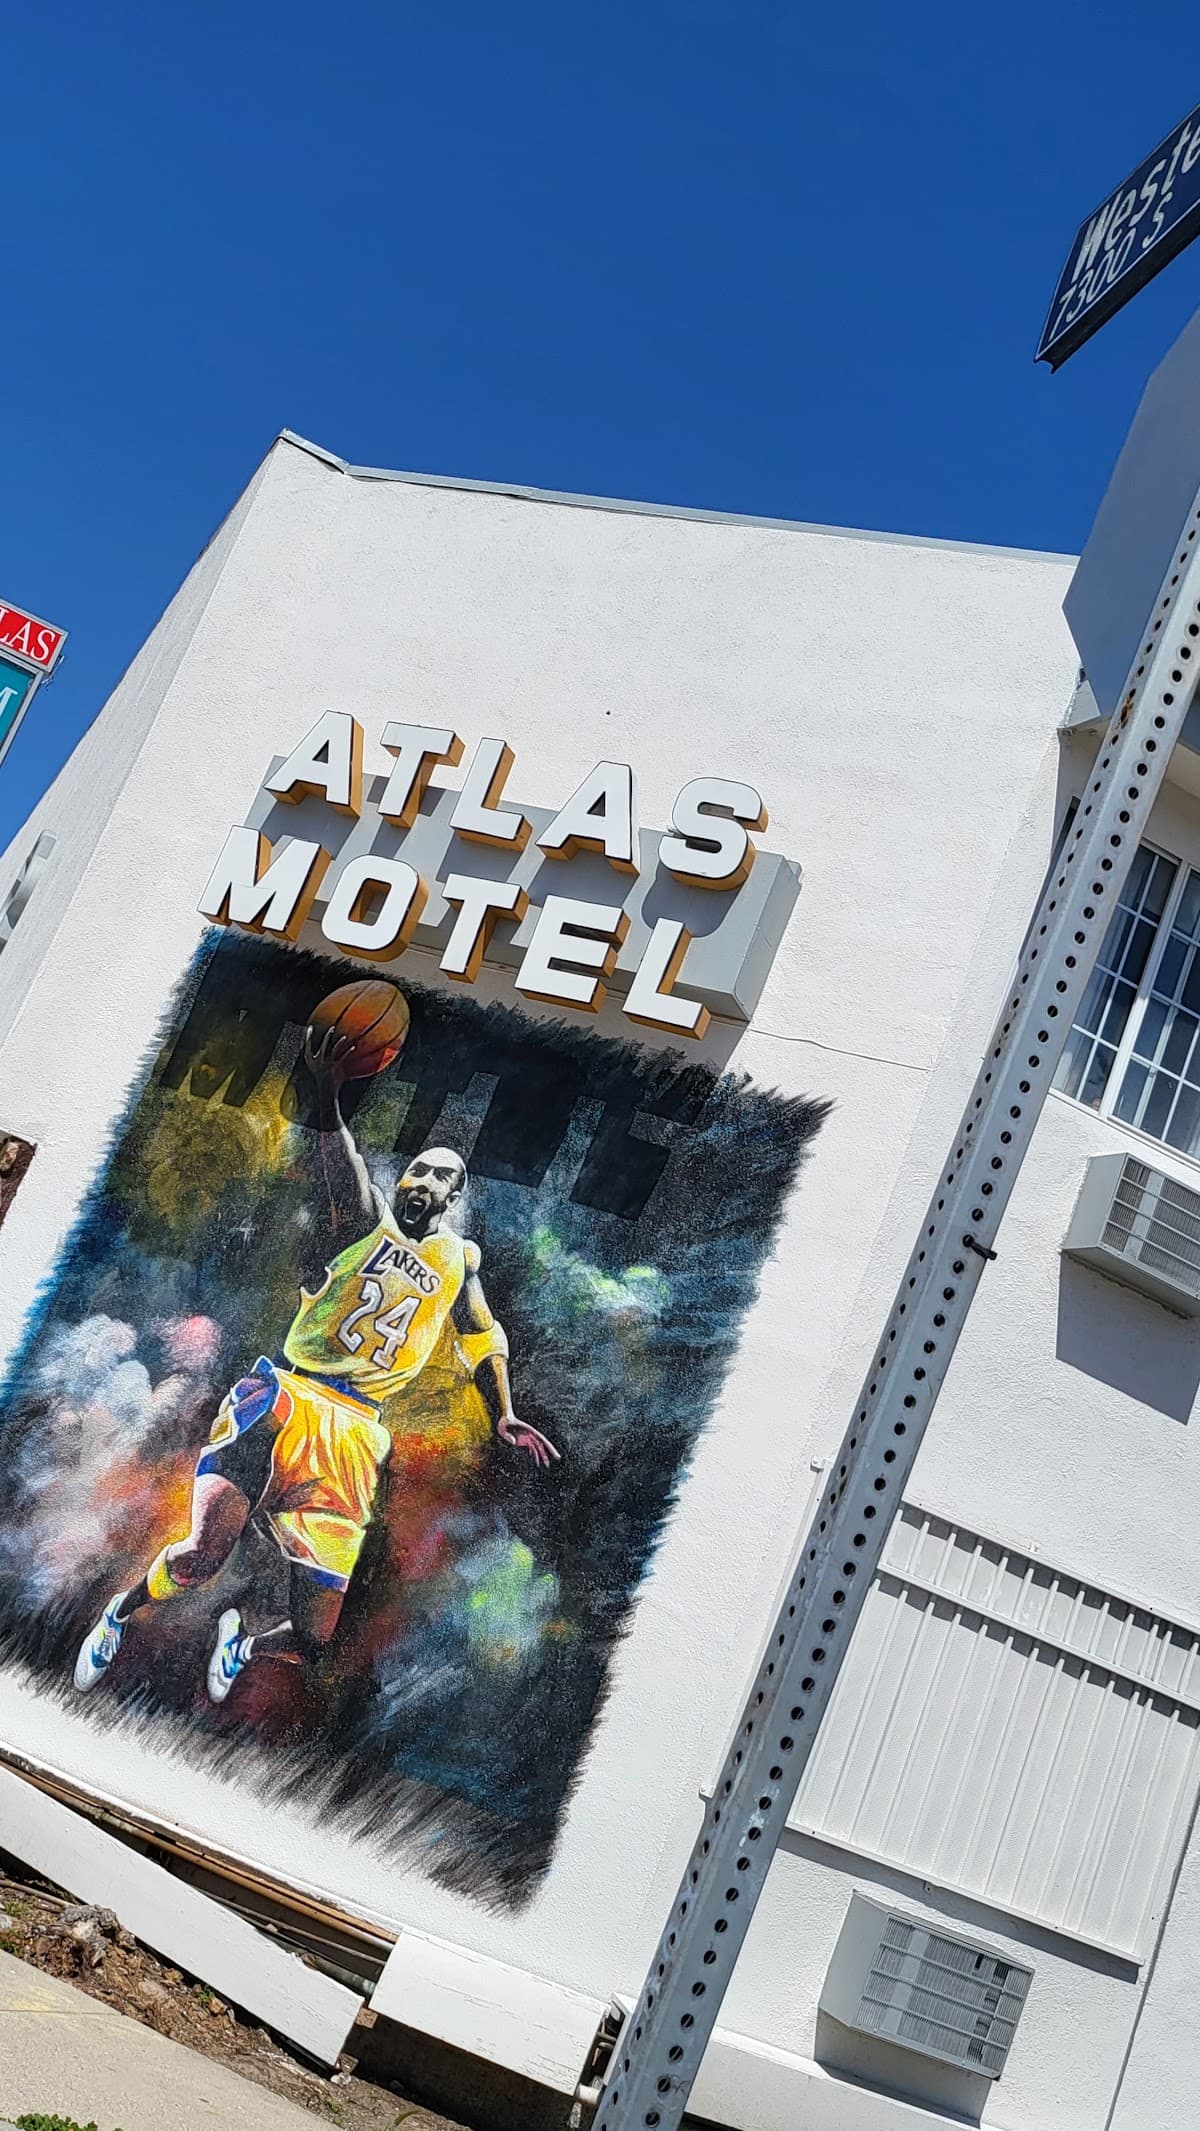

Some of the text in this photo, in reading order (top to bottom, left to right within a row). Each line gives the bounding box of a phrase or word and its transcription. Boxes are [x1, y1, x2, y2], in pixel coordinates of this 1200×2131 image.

[1048, 192, 1173, 342] 7300 S
[263, 710, 769, 891] ATLAS
[197, 825, 711, 1040] MOTEL
[337, 1278, 422, 1371] 24
[359, 1236, 441, 1294] LAKERS
